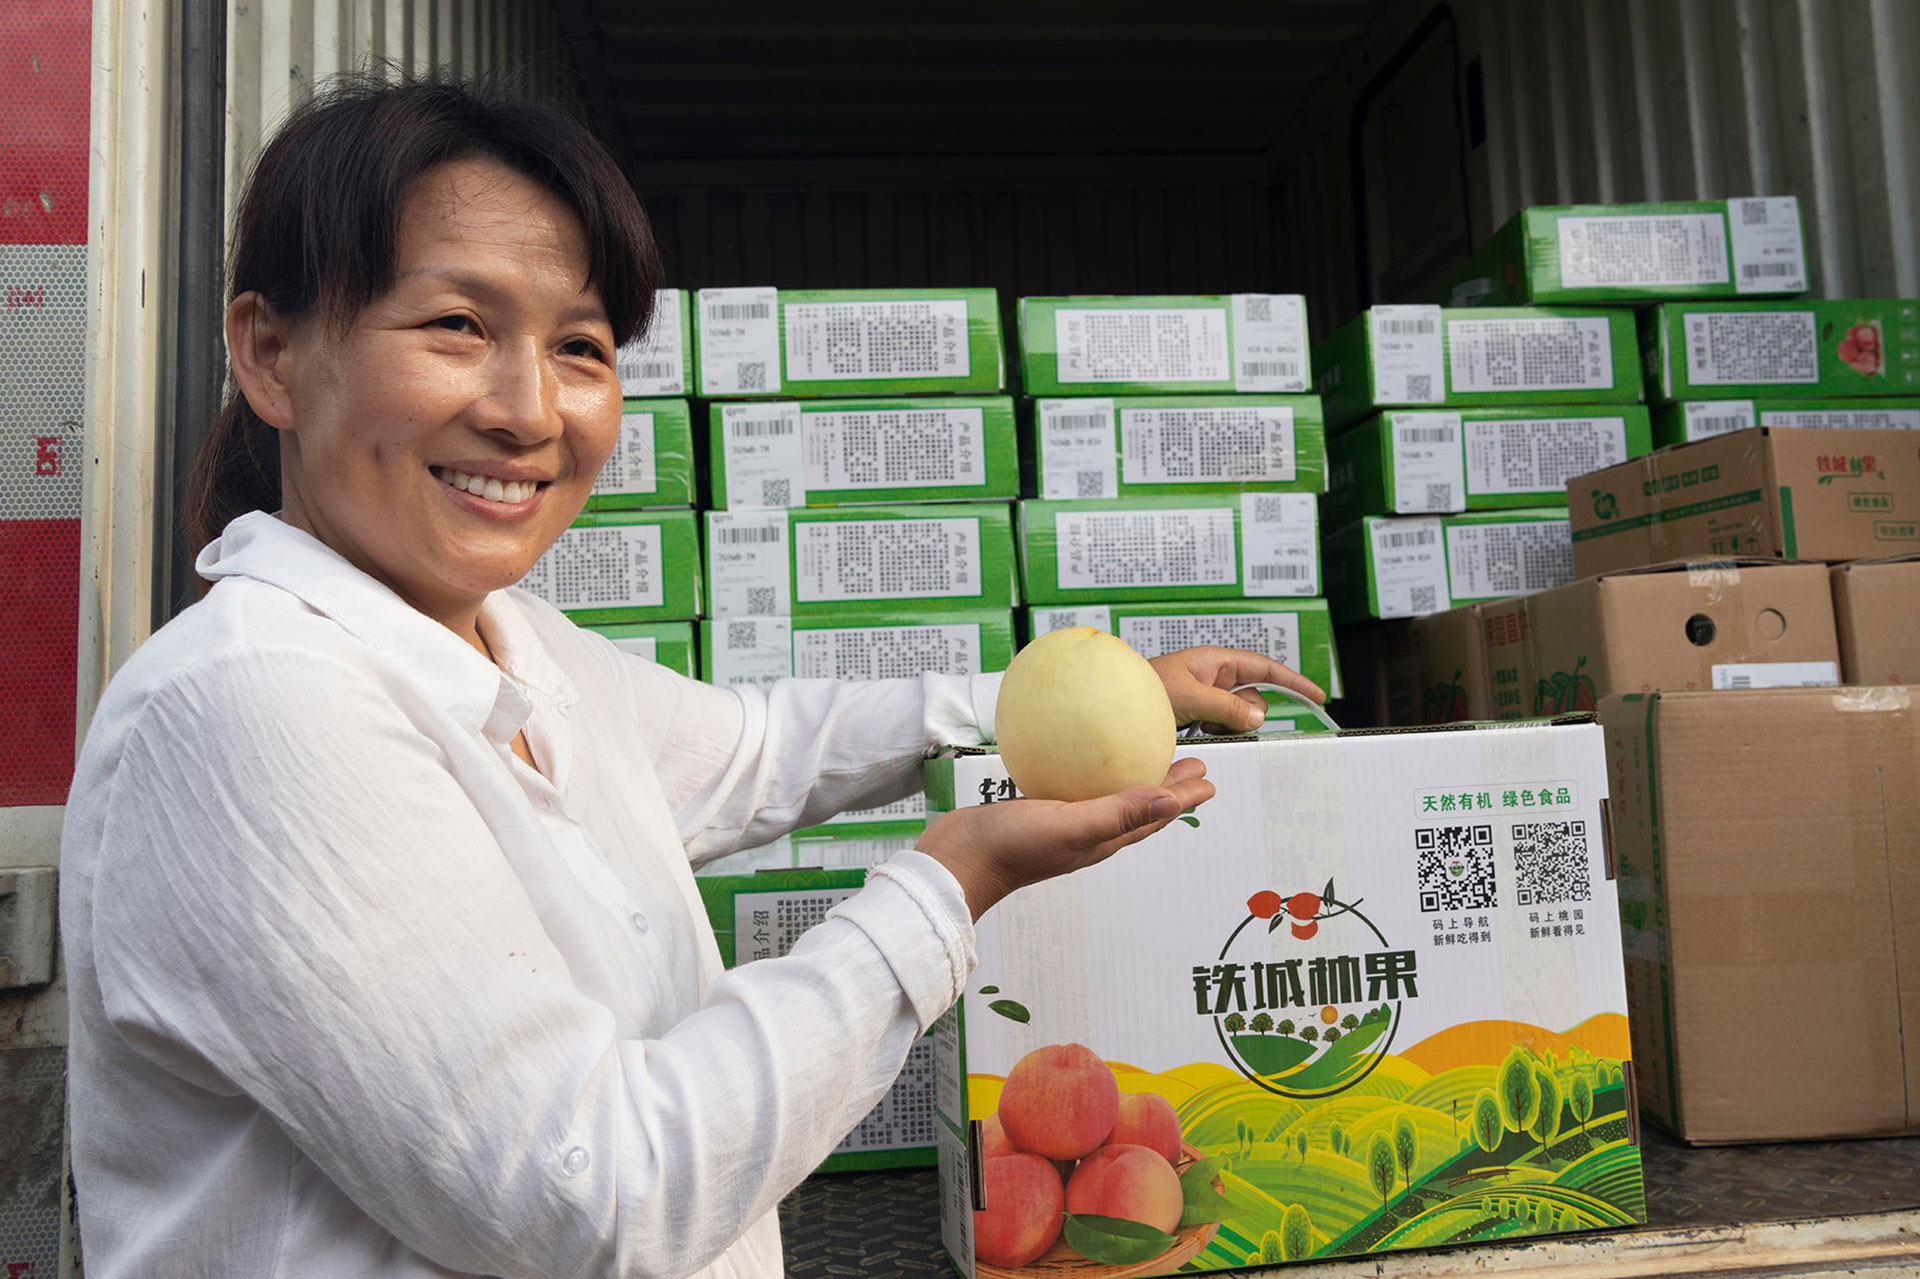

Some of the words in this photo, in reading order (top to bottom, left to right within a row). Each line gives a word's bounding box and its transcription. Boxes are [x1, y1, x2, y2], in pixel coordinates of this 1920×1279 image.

[942, 313, 956, 365] 产品介绍
[958, 421, 972, 473] 产品介绍
[1269, 419, 1284, 470] 产品介绍
[634, 539, 649, 594] 产品介绍
[954, 531, 968, 584] 产品介绍
[1422, 791, 1493, 813] 天然有机
[1502, 787, 1572, 808] 绿色食品
[1432, 915, 1490, 931] 码上导航
[1433, 929, 1491, 947] 新鲜吃得到
[1529, 909, 1584, 924] 码上桃园
[1530, 923, 1585, 939] 新鲜看得见
[1192, 949, 1419, 1015] 铁城林果
